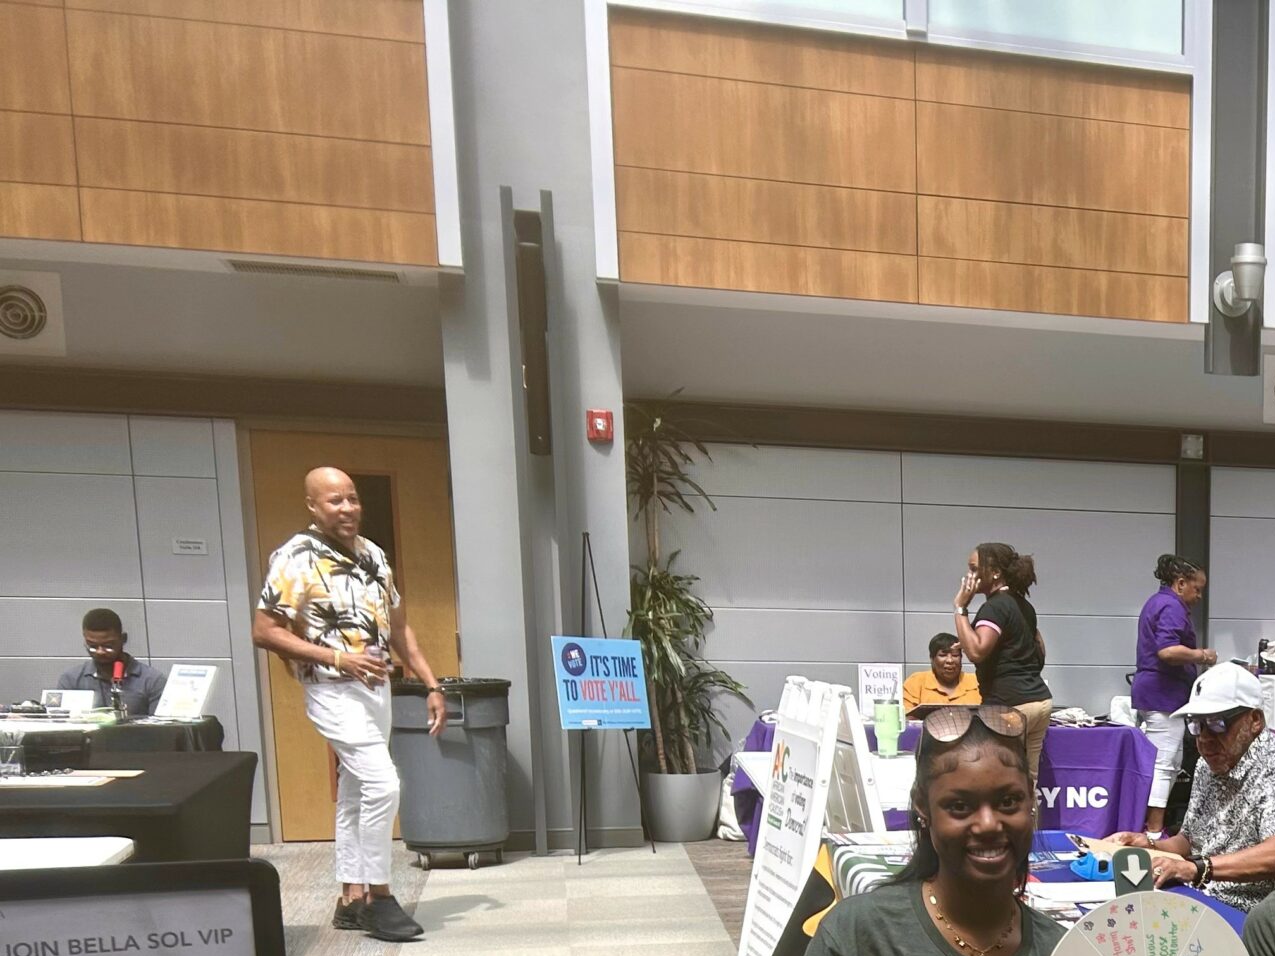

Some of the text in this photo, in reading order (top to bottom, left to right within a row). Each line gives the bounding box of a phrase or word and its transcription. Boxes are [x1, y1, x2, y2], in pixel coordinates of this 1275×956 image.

[590, 655, 638, 678] IT'S TIME
[864, 669, 898, 681] Voting
[563, 679, 578, 701] TO
[580, 680, 608, 701] VOTE
[1066, 786, 1109, 809] NC
[67, 935, 140, 955] BELLA
[147, 931, 192, 949] SOL
[198, 928, 234, 945] VIP
